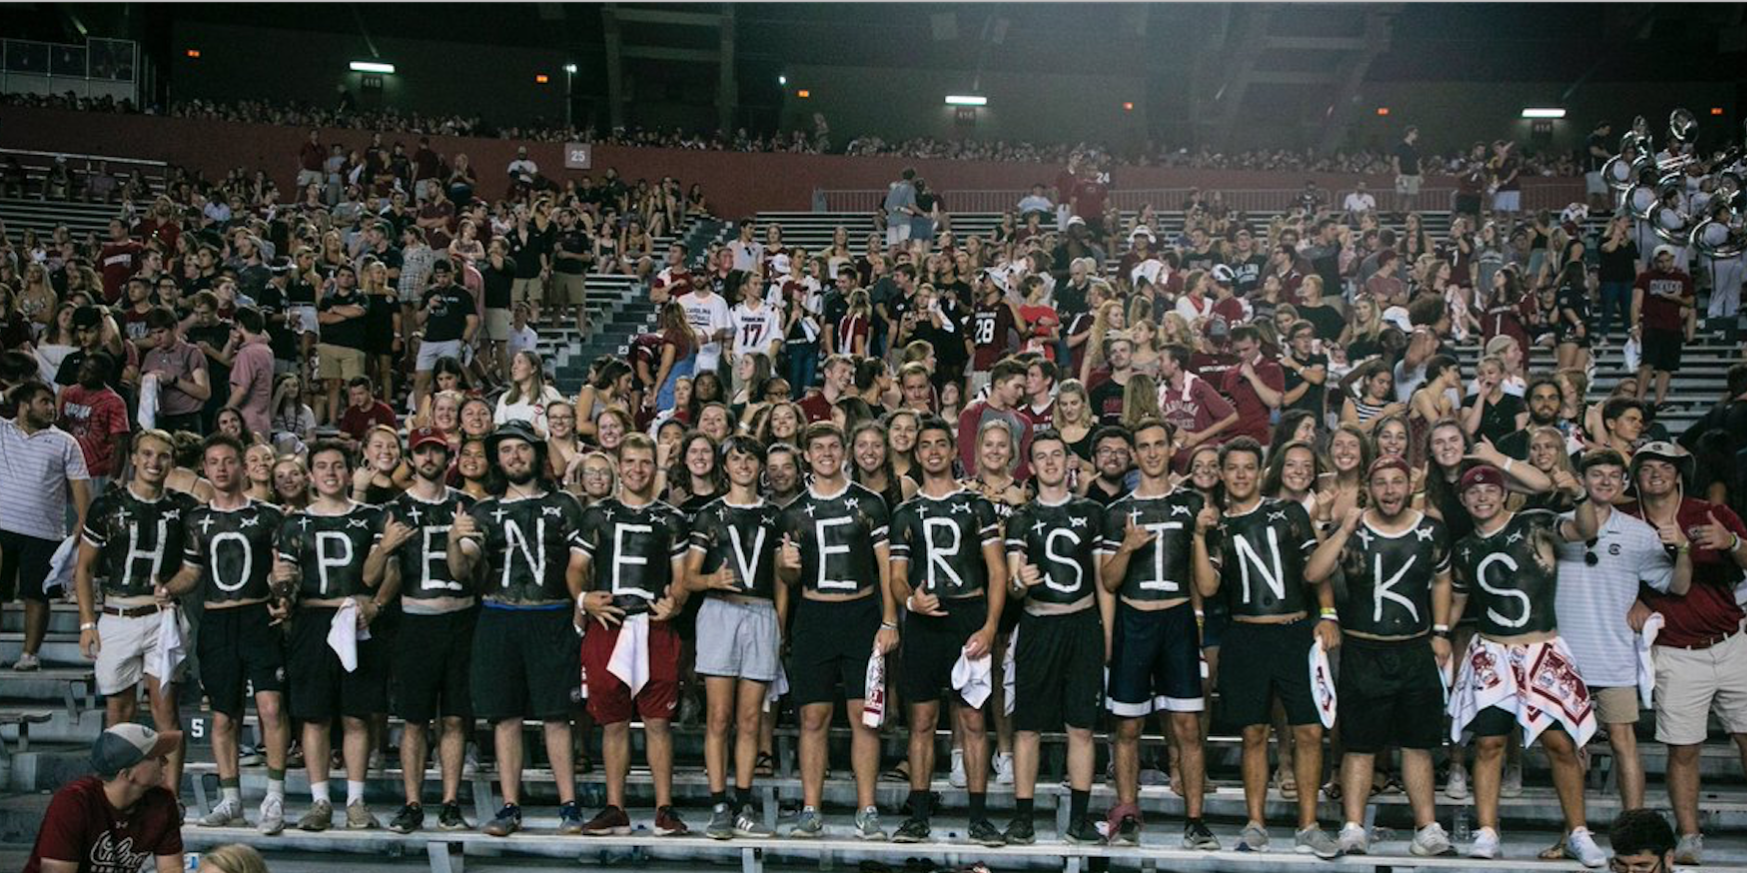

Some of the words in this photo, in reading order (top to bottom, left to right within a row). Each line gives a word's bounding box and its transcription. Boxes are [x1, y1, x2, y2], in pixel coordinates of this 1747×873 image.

[571, 150, 586, 162] 25
[1096, 172, 1110, 183] 24
[742, 324, 763, 346] 17
[975, 318, 995, 344] 28
[122, 519, 167, 586] H
[210, 532, 252, 592] O
[315, 531, 353, 594] P
[420, 525, 463, 591] E
[501, 518, 546, 588] N
[612, 523, 655, 599] E
[727, 524, 766, 590] V
[815, 516, 857, 590] E
[923, 517, 963, 590] R
[1043, 528, 1083, 593] S
[1139, 522, 1183, 592] I
[1233, 526, 1285, 603] N
[1373, 553, 1420, 623] K
[1477, 552, 1531, 627] S
